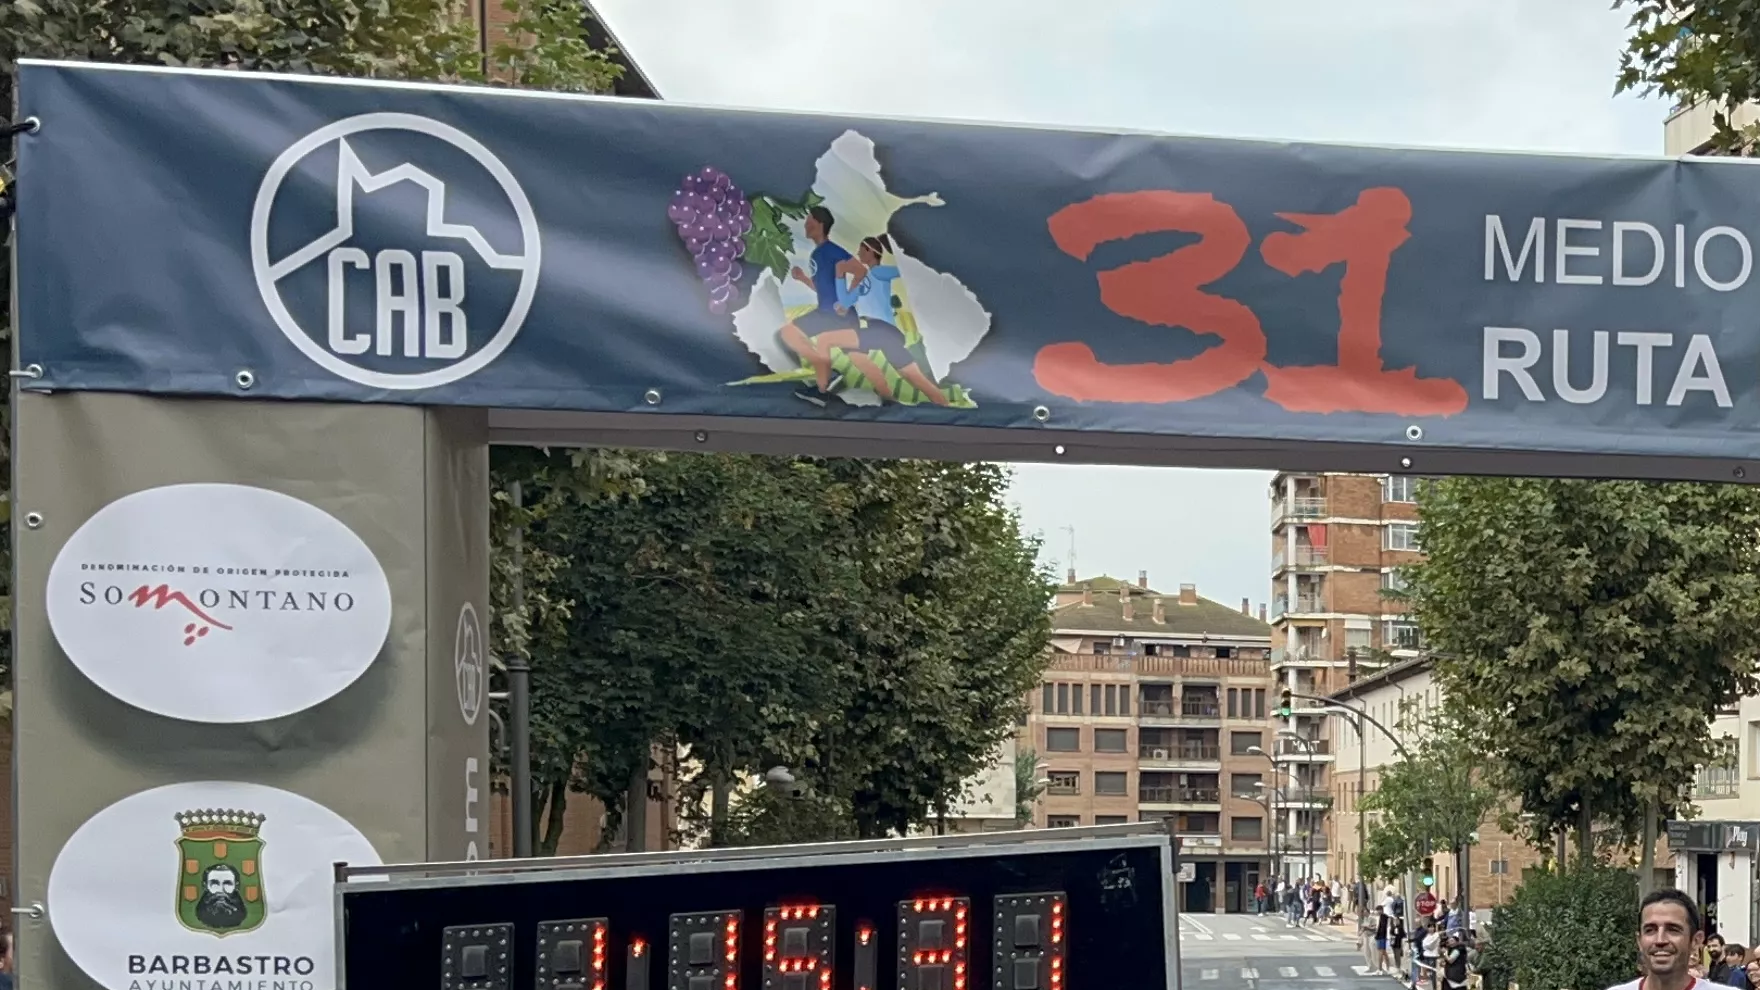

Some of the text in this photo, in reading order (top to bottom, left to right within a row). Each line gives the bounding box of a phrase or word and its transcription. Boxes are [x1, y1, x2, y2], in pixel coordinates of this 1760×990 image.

[1484, 214, 1753, 294] MEDIO
[328, 247, 467, 359] CAB
[1034, 186, 1469, 418] 31
[1483, 327, 1731, 406] RUTA
[80, 582, 354, 631] SOMONTANO
[81, 563, 350, 578] DENOMINACIÓN DE ORIGEN PROTEGIDA
[128, 954, 315, 976] BARBASTRO
